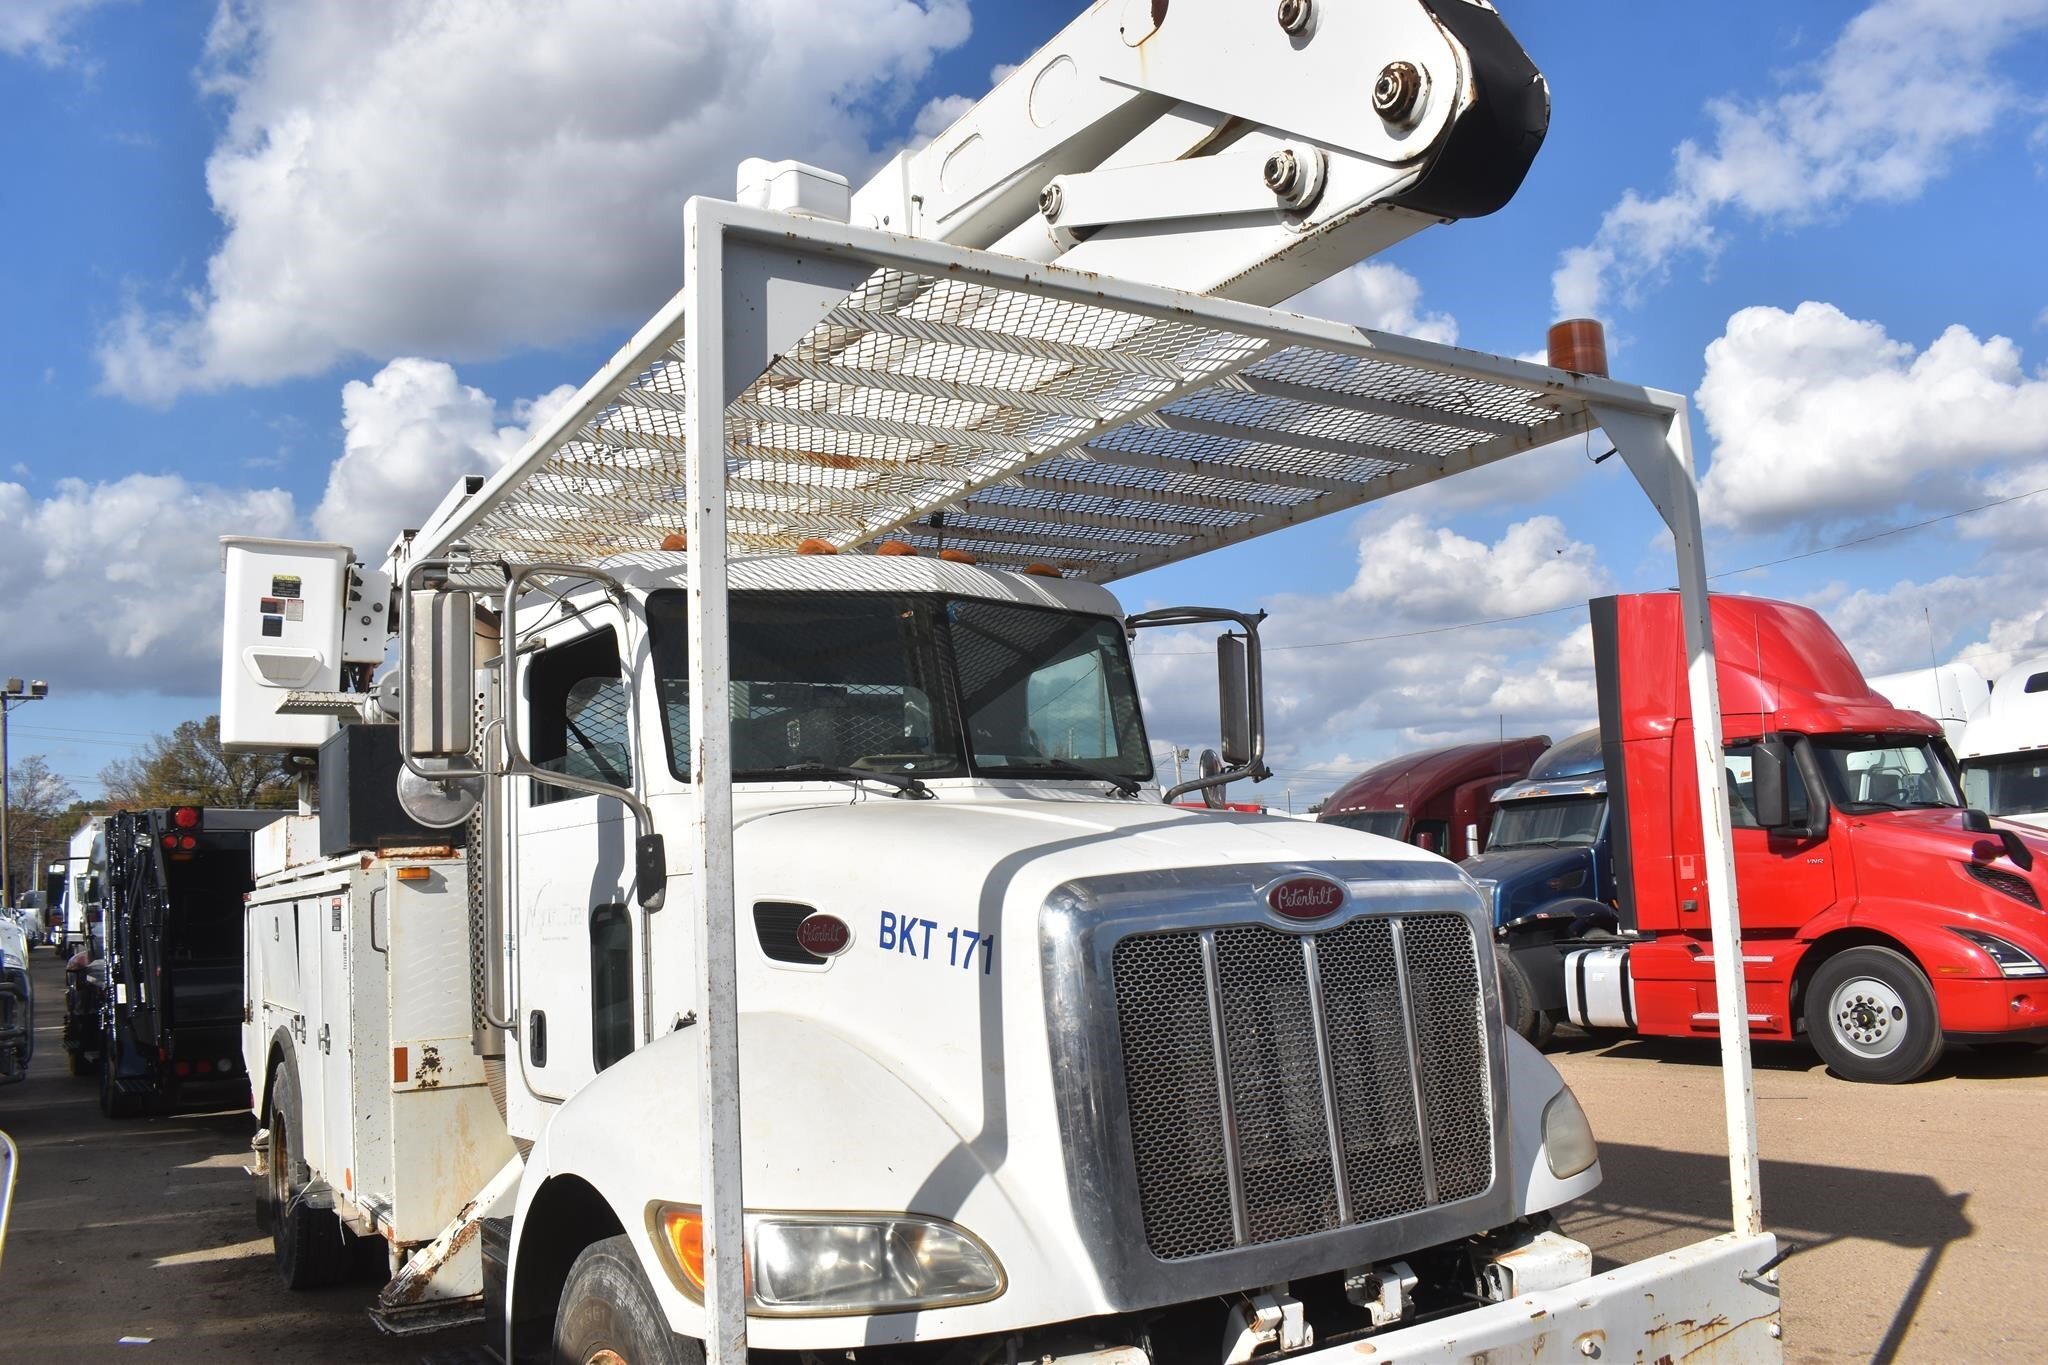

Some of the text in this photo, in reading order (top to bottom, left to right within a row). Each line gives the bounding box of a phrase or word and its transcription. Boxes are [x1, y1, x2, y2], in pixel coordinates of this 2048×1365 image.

[1278, 886, 1337, 910] Peterbilt
[879, 910, 994, 975] BKT 171
